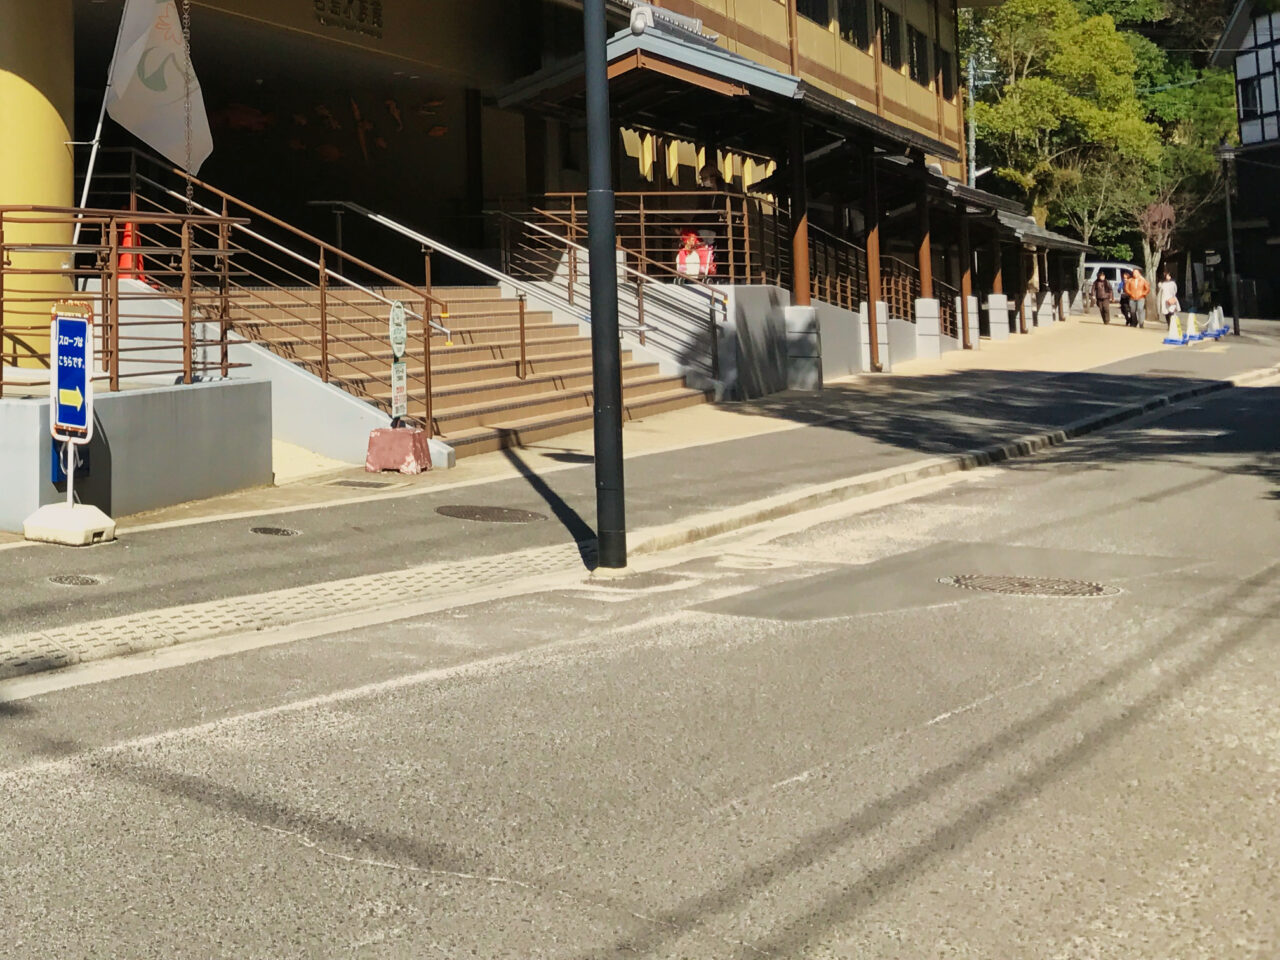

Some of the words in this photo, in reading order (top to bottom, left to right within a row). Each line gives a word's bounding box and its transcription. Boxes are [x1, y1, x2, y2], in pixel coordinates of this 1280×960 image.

[59, 336, 83, 347] スロープは
